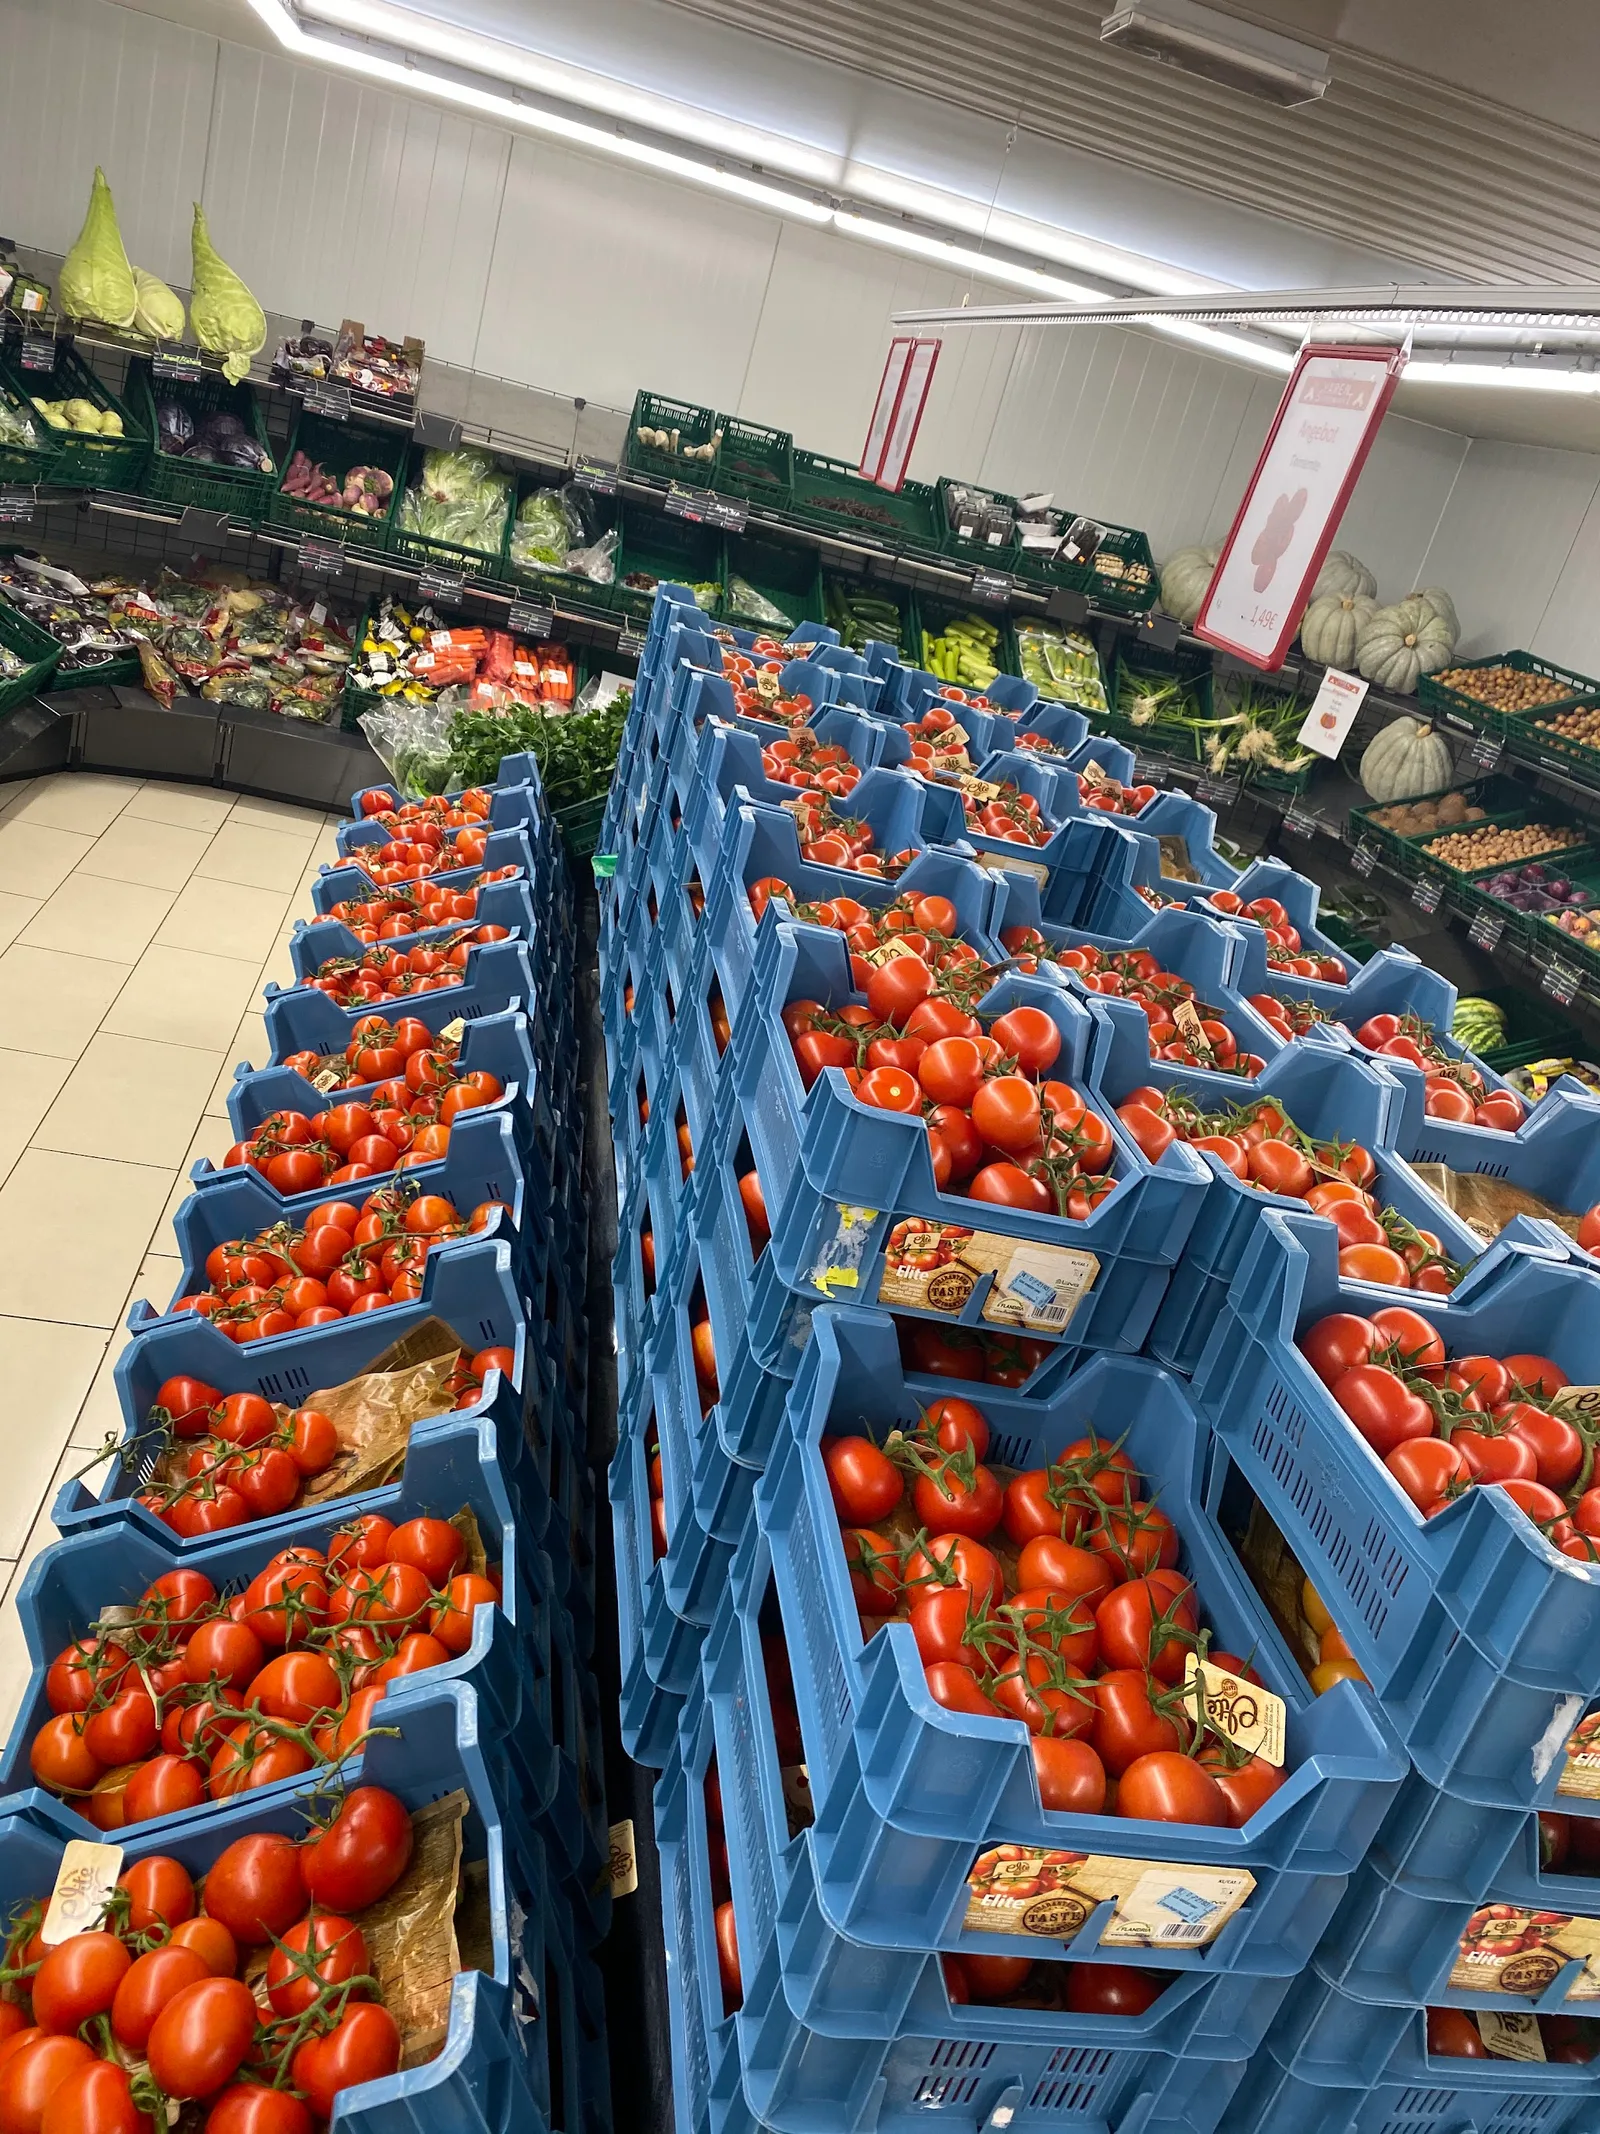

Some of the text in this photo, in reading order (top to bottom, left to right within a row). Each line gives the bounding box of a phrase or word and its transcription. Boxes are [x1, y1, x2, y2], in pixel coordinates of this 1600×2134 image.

[1299, 420, 1340, 444] Angebot
[1250, 605, 1278, 631] 1,49€
[896, 1265, 929, 1282] Elite
[931, 1286, 971, 1297] TASTE
[980, 1893, 1026, 1910] Elite
[1028, 1911, 1082, 1923] TASTE
[1465, 1951, 1507, 1967] Elite
[1506, 1969, 1556, 1980] TASTE
